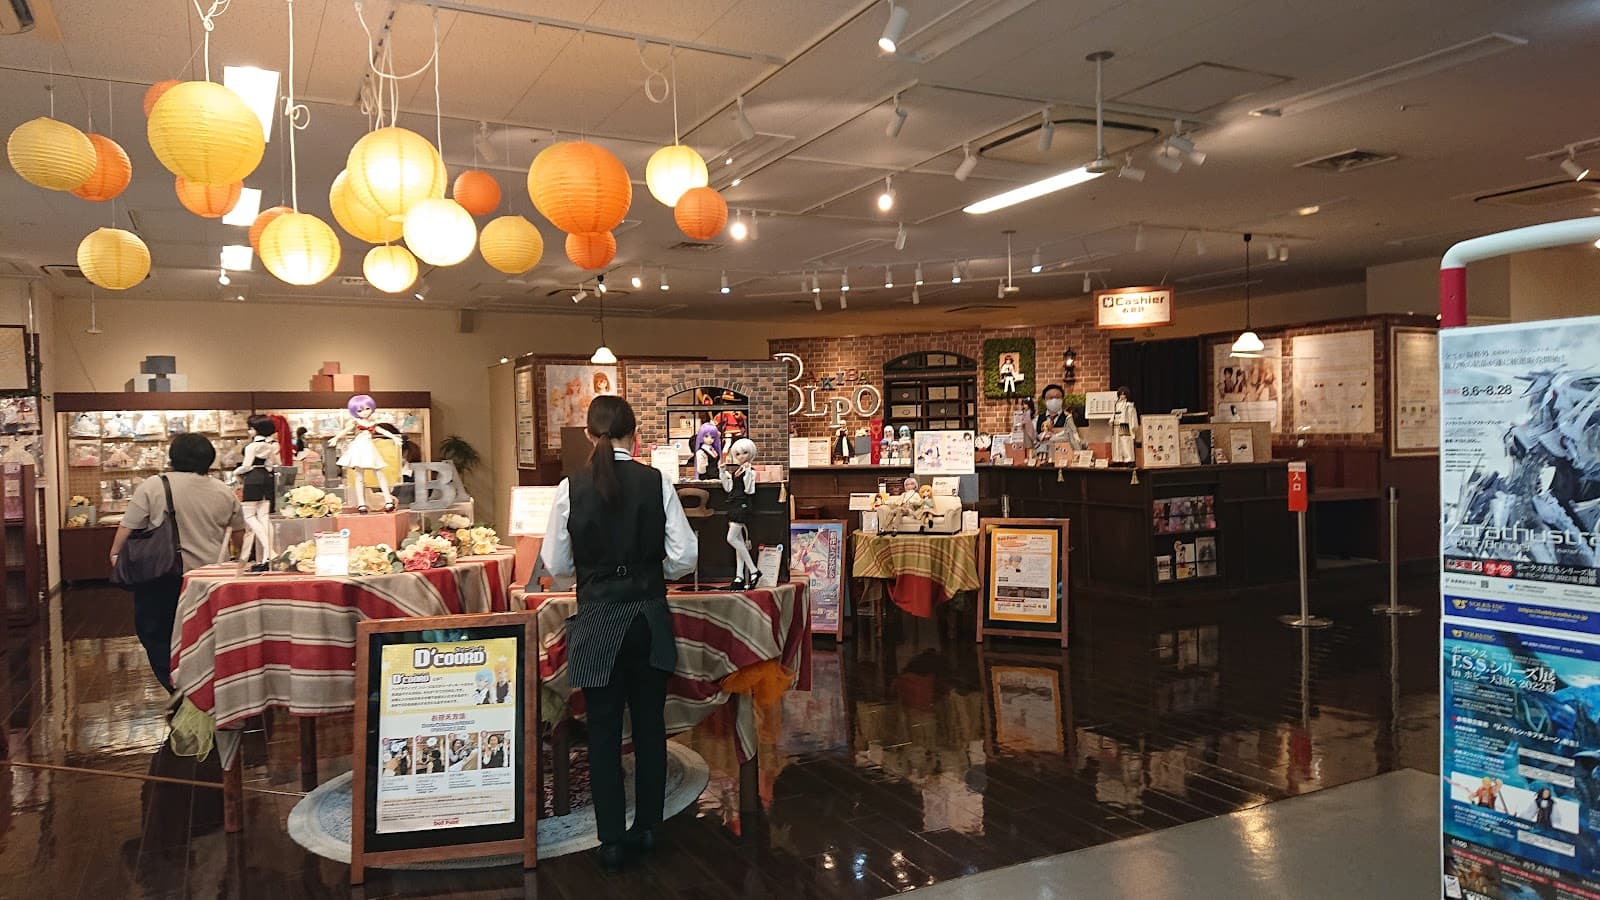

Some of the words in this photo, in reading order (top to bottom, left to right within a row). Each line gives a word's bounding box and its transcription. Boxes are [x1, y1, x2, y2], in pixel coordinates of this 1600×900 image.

[1115, 295, 1165, 306] Cashier
[806, 368, 873, 391] AKIBA
[1292, 472, 1302, 492] 入口
[1450, 645, 1488, 658] ボークス
[1451, 669, 1461, 678] in
